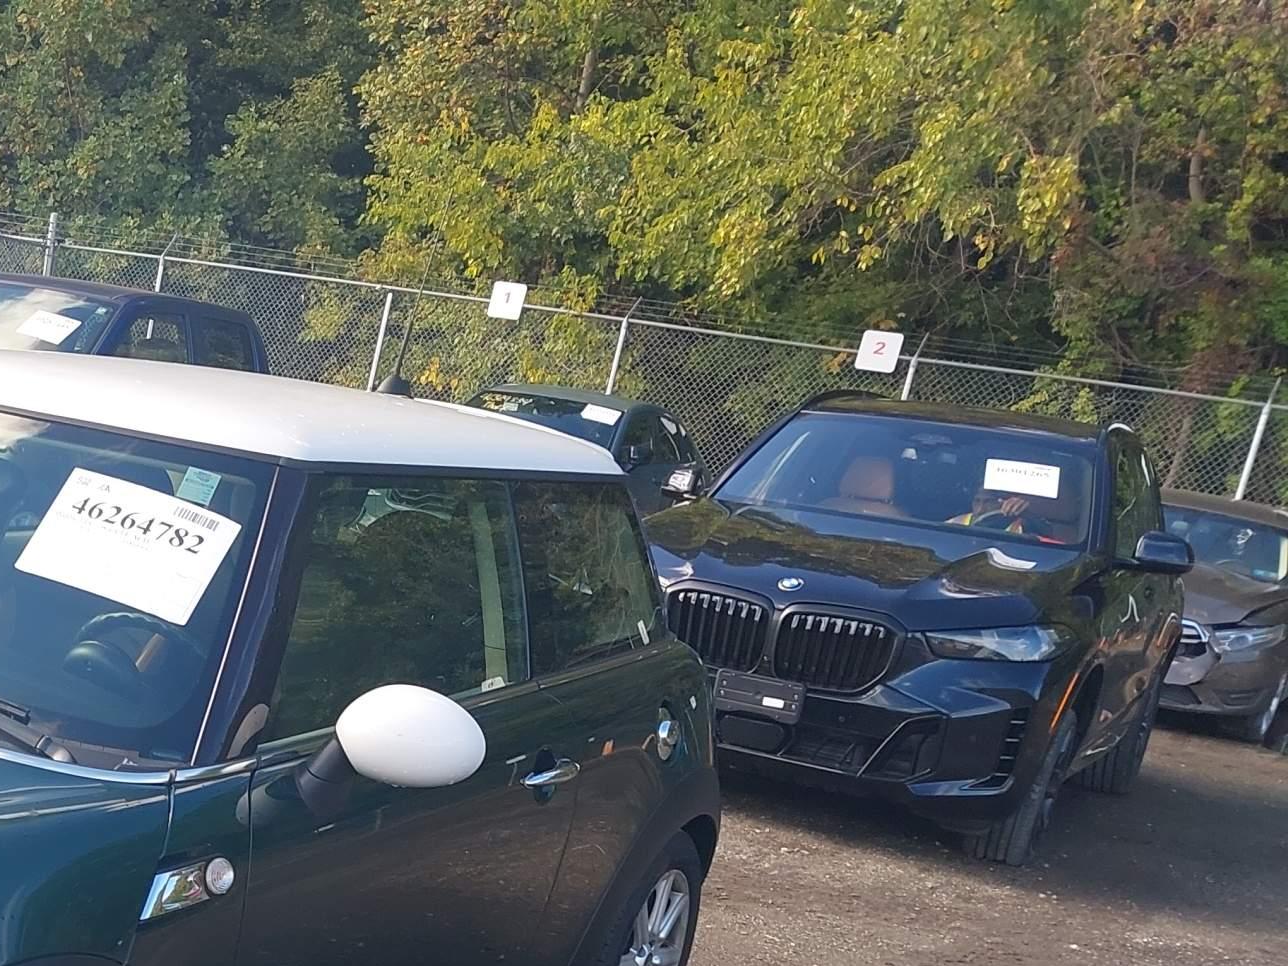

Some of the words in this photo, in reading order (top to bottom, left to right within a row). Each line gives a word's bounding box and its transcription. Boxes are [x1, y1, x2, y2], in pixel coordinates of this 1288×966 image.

[504, 291, 511, 304] 1
[873, 341, 886, 355] 2
[71, 497, 205, 554] 46264782
